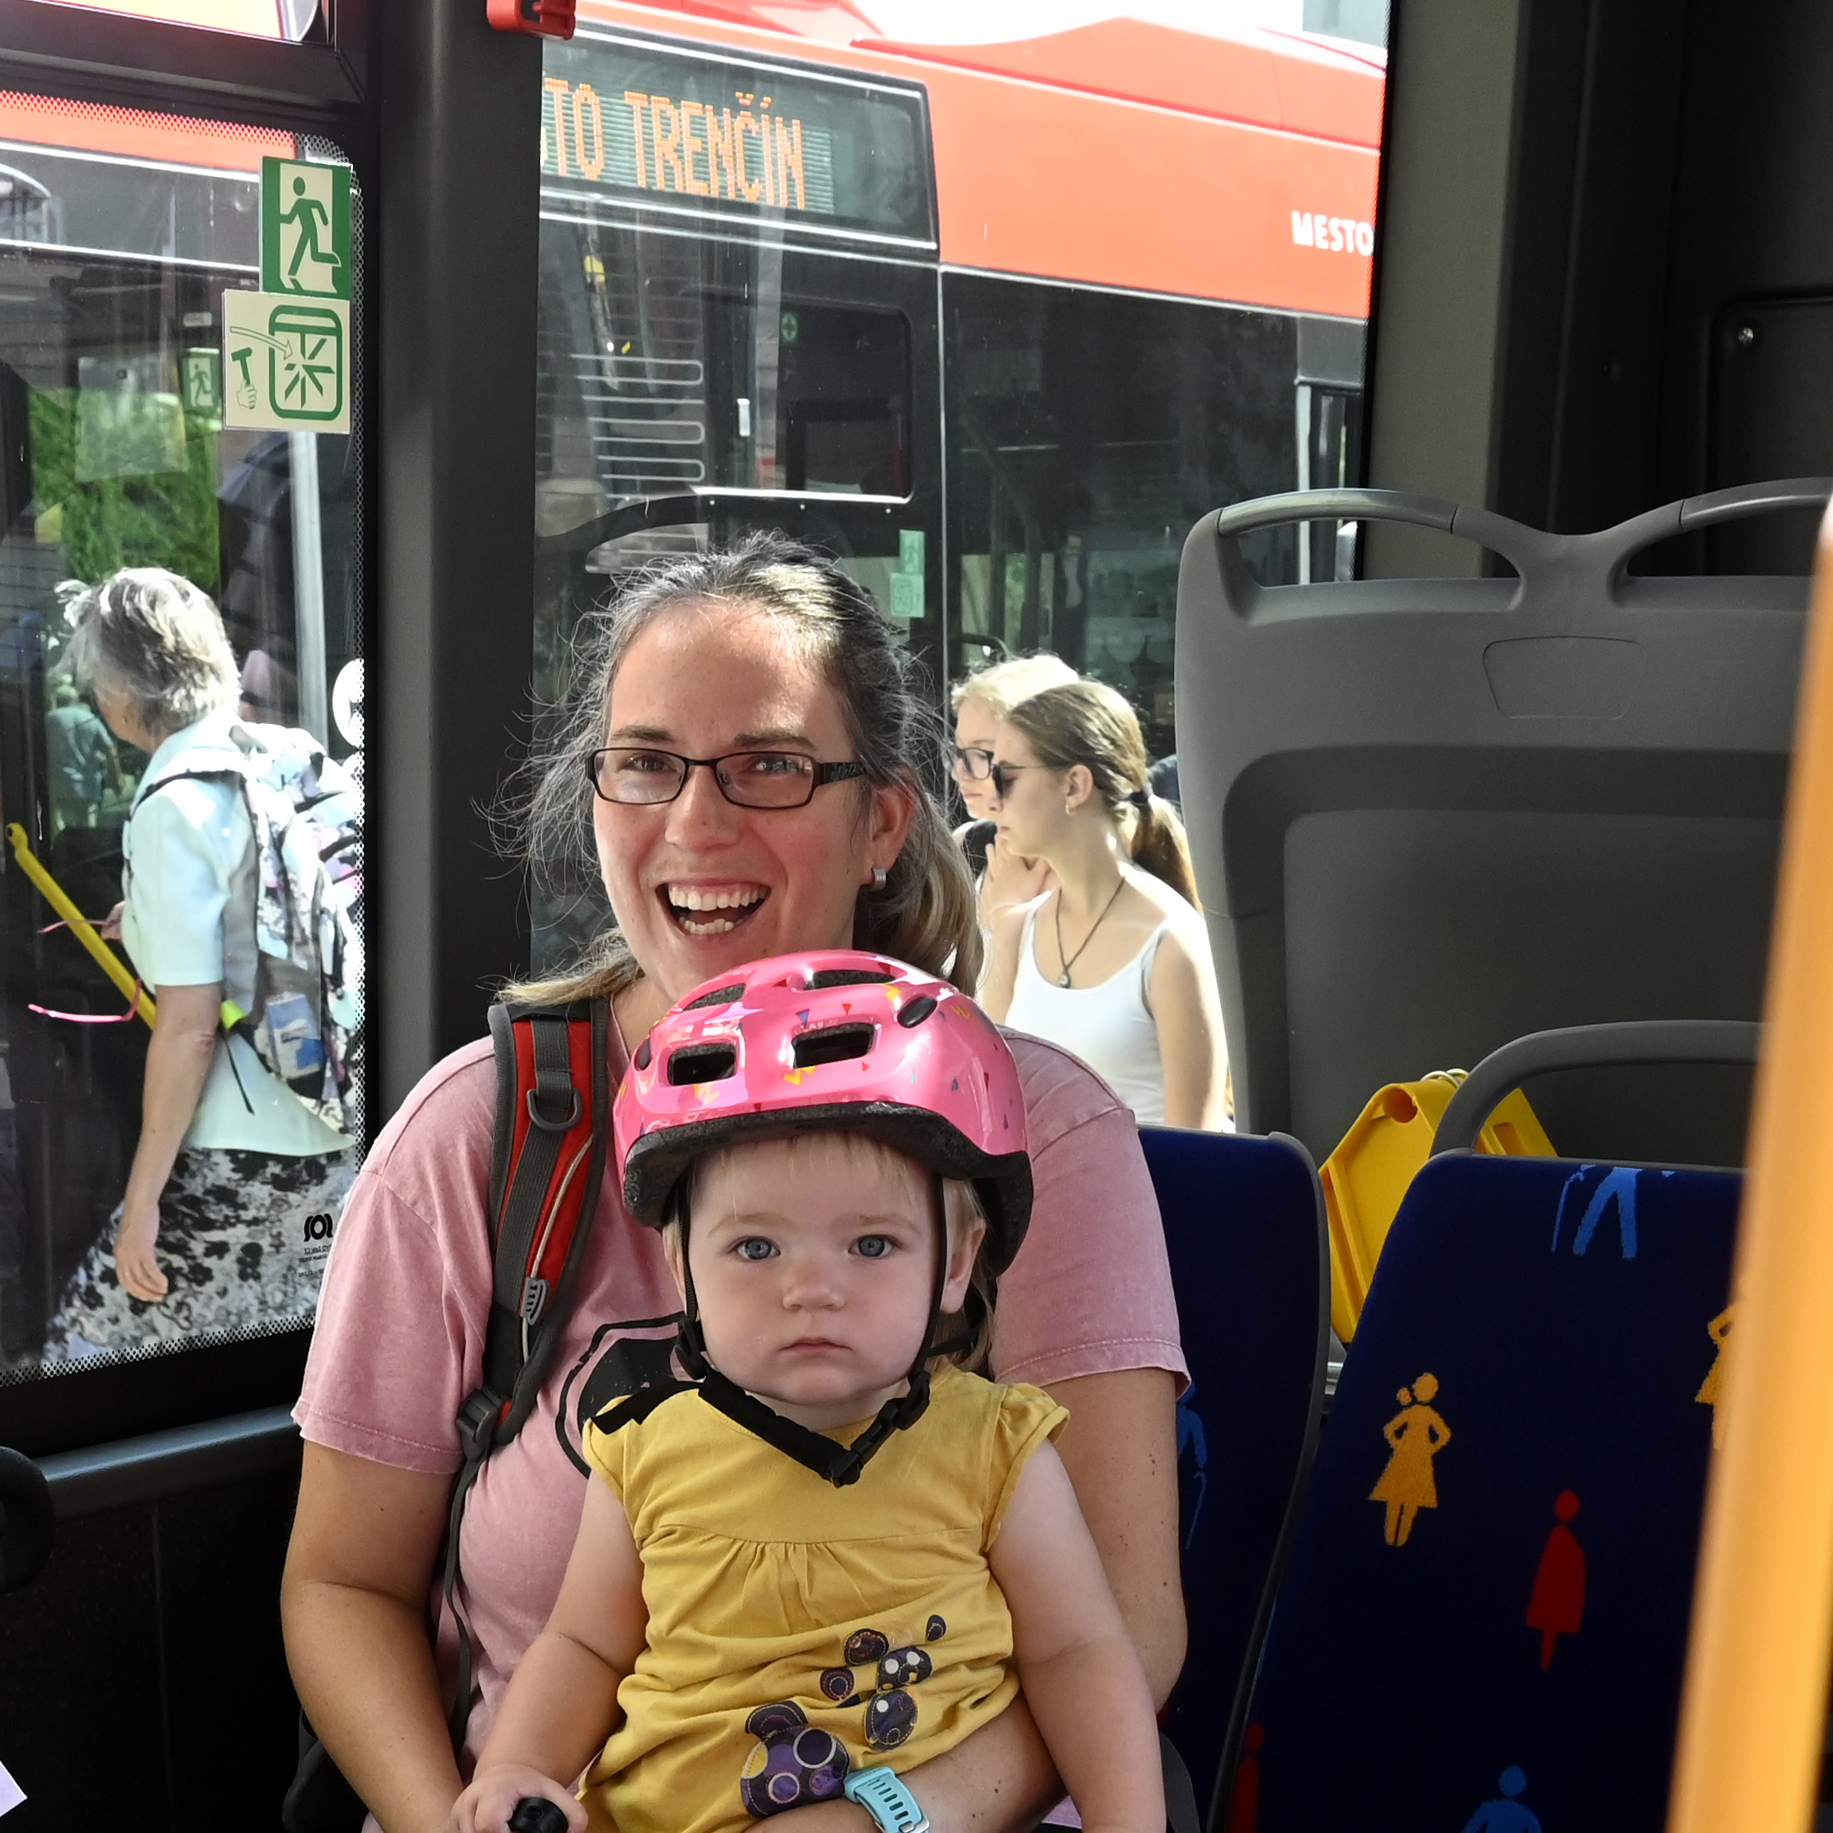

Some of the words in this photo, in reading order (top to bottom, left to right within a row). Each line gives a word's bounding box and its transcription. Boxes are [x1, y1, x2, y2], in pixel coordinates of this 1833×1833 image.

[540, 76, 605, 181] TO
[624, 90, 806, 210] TRENČÍN
[1290, 209, 1375, 257] MESTO
